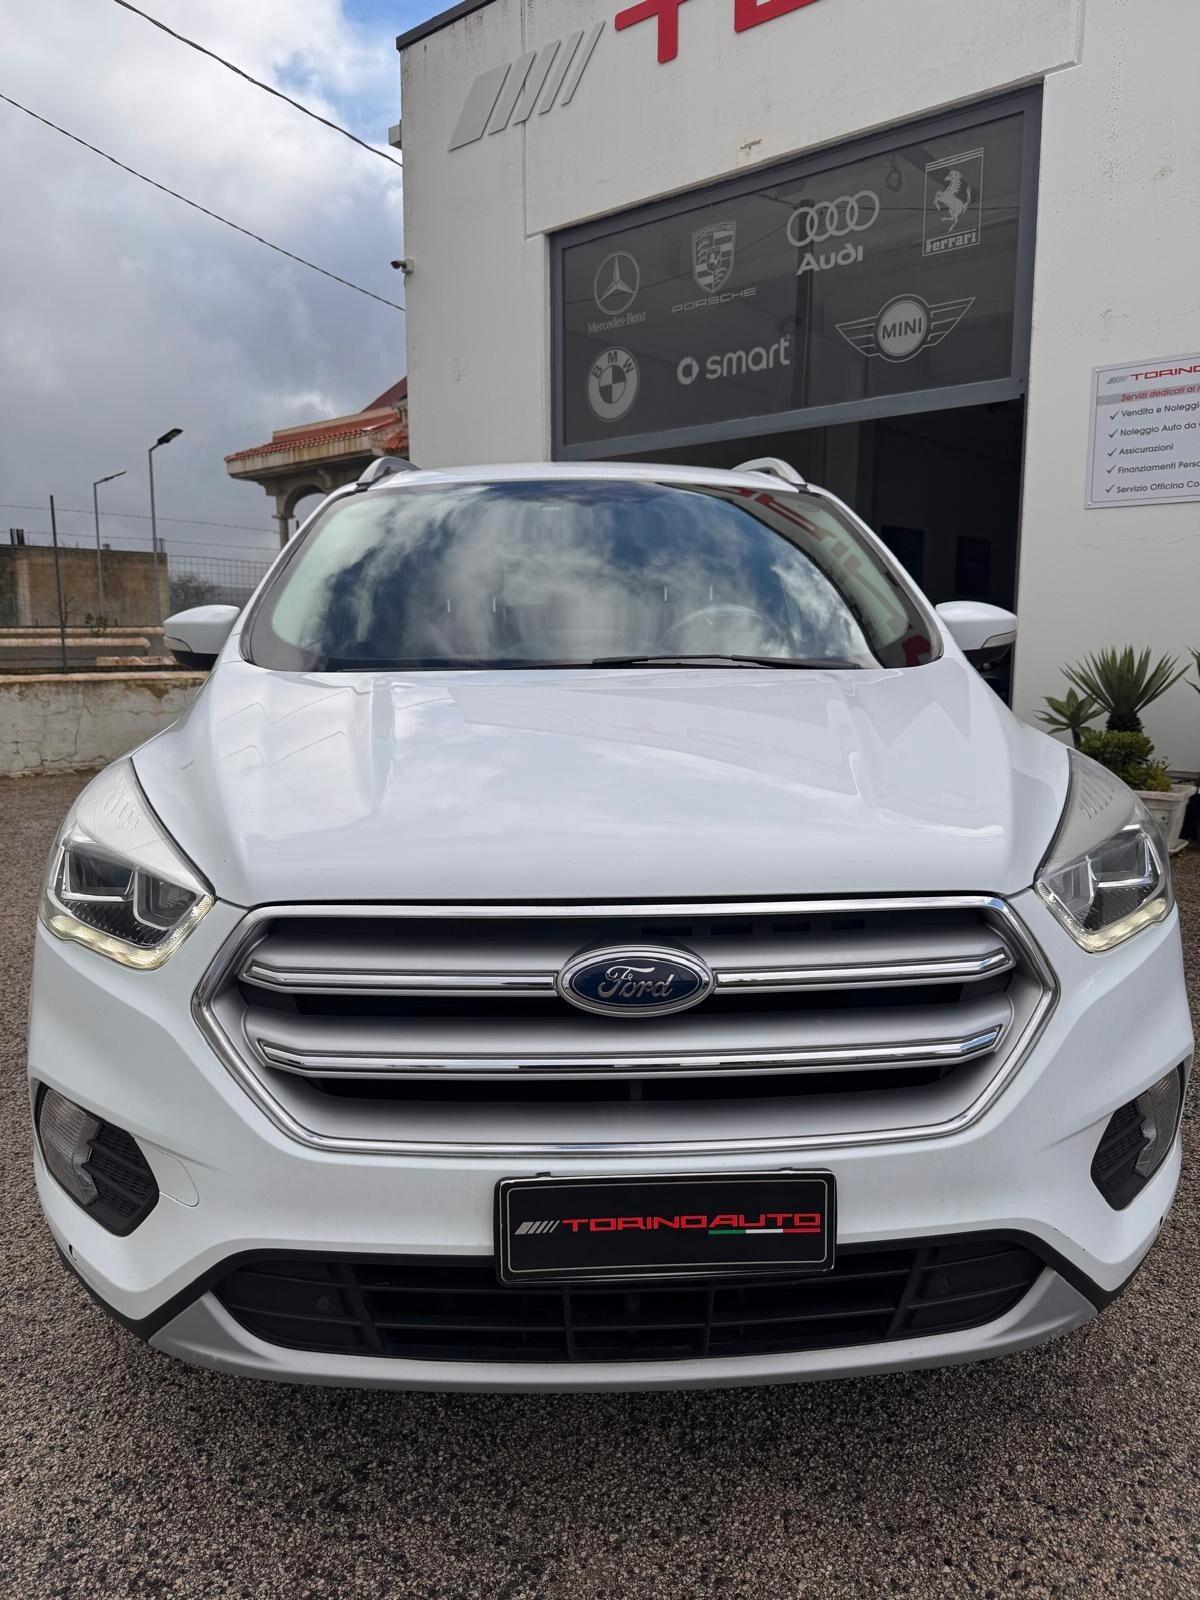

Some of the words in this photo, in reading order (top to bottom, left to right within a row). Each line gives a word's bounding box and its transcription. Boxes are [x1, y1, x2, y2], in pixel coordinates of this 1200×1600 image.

[925, 231, 977, 253] Ferrari
[796, 243, 864, 276] Audi
[672, 287, 757, 313] PORSCHE
[588, 312, 647, 333] Mercedes-Benz
[882, 318, 923, 340] MINI
[592, 351, 634, 378] BMW
[705, 338, 791, 379] smart
[1121, 392, 1148, 402] Servizi
[1149, 385, 1185, 398] dedicati
[1121, 406, 1154, 417] Vendita
[1156, 406, 1162, 414] e
[1120, 426, 1160, 436] Noleggio
[1161, 424, 1182, 432] Auto
[1184, 422, 1196, 430] da
[1119, 443, 1174, 455] Assicurazioni
[1118, 462, 1176, 474] Finanziamenti
[1116, 484, 1148, 493] Servizio
[1150, 482, 1184, 491] Officina
[597, 965, 675, 998] Ford
